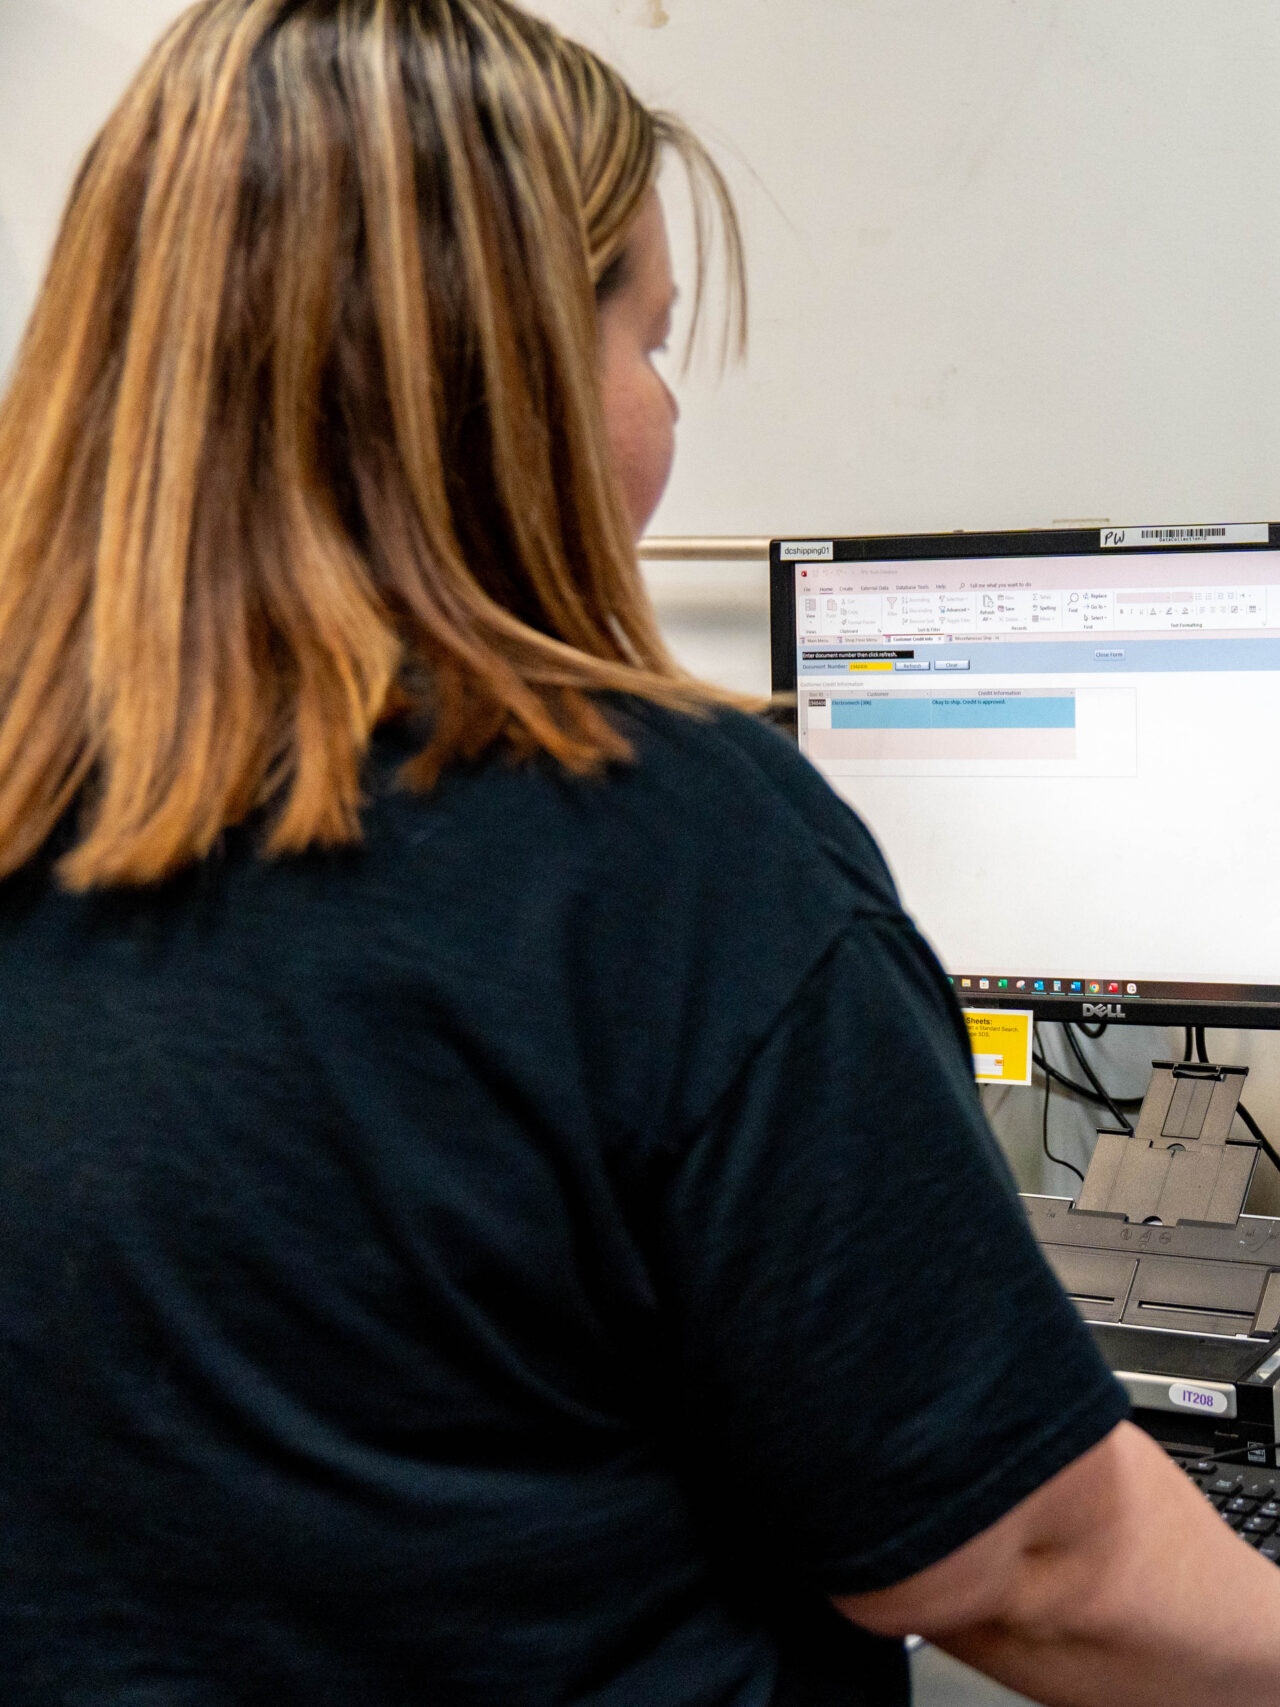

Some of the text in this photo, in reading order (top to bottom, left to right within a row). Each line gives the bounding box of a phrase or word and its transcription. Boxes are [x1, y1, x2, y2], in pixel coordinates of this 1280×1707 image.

[784, 545, 831, 556] dcshipping01
[1082, 1003, 1126, 1018] DELL
[966, 1017, 993, 1025] Sheets:
[1182, 1389, 1214, 1407] IT208
